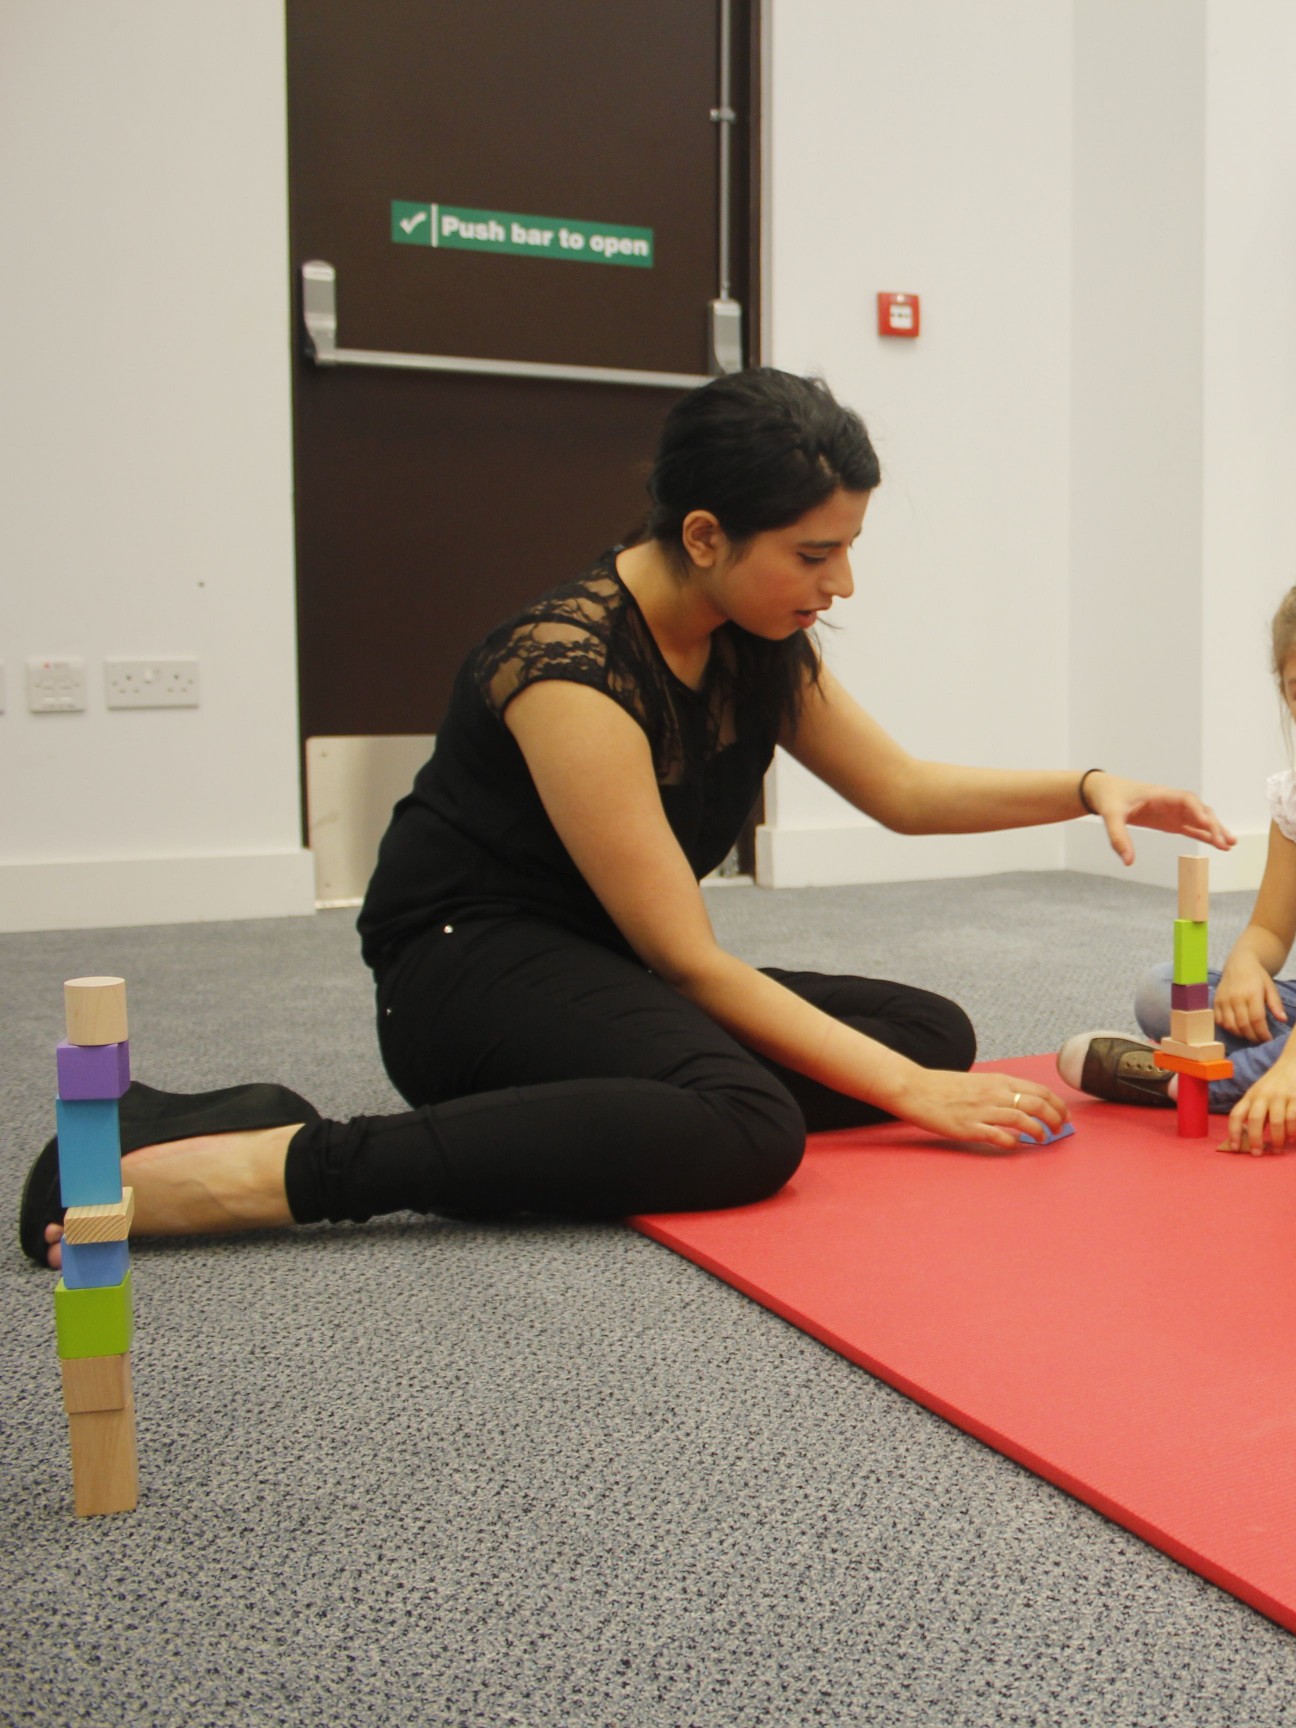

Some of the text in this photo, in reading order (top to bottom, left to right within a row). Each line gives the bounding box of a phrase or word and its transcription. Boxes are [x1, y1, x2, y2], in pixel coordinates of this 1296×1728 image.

[440, 214, 649, 258] Push bar to open
